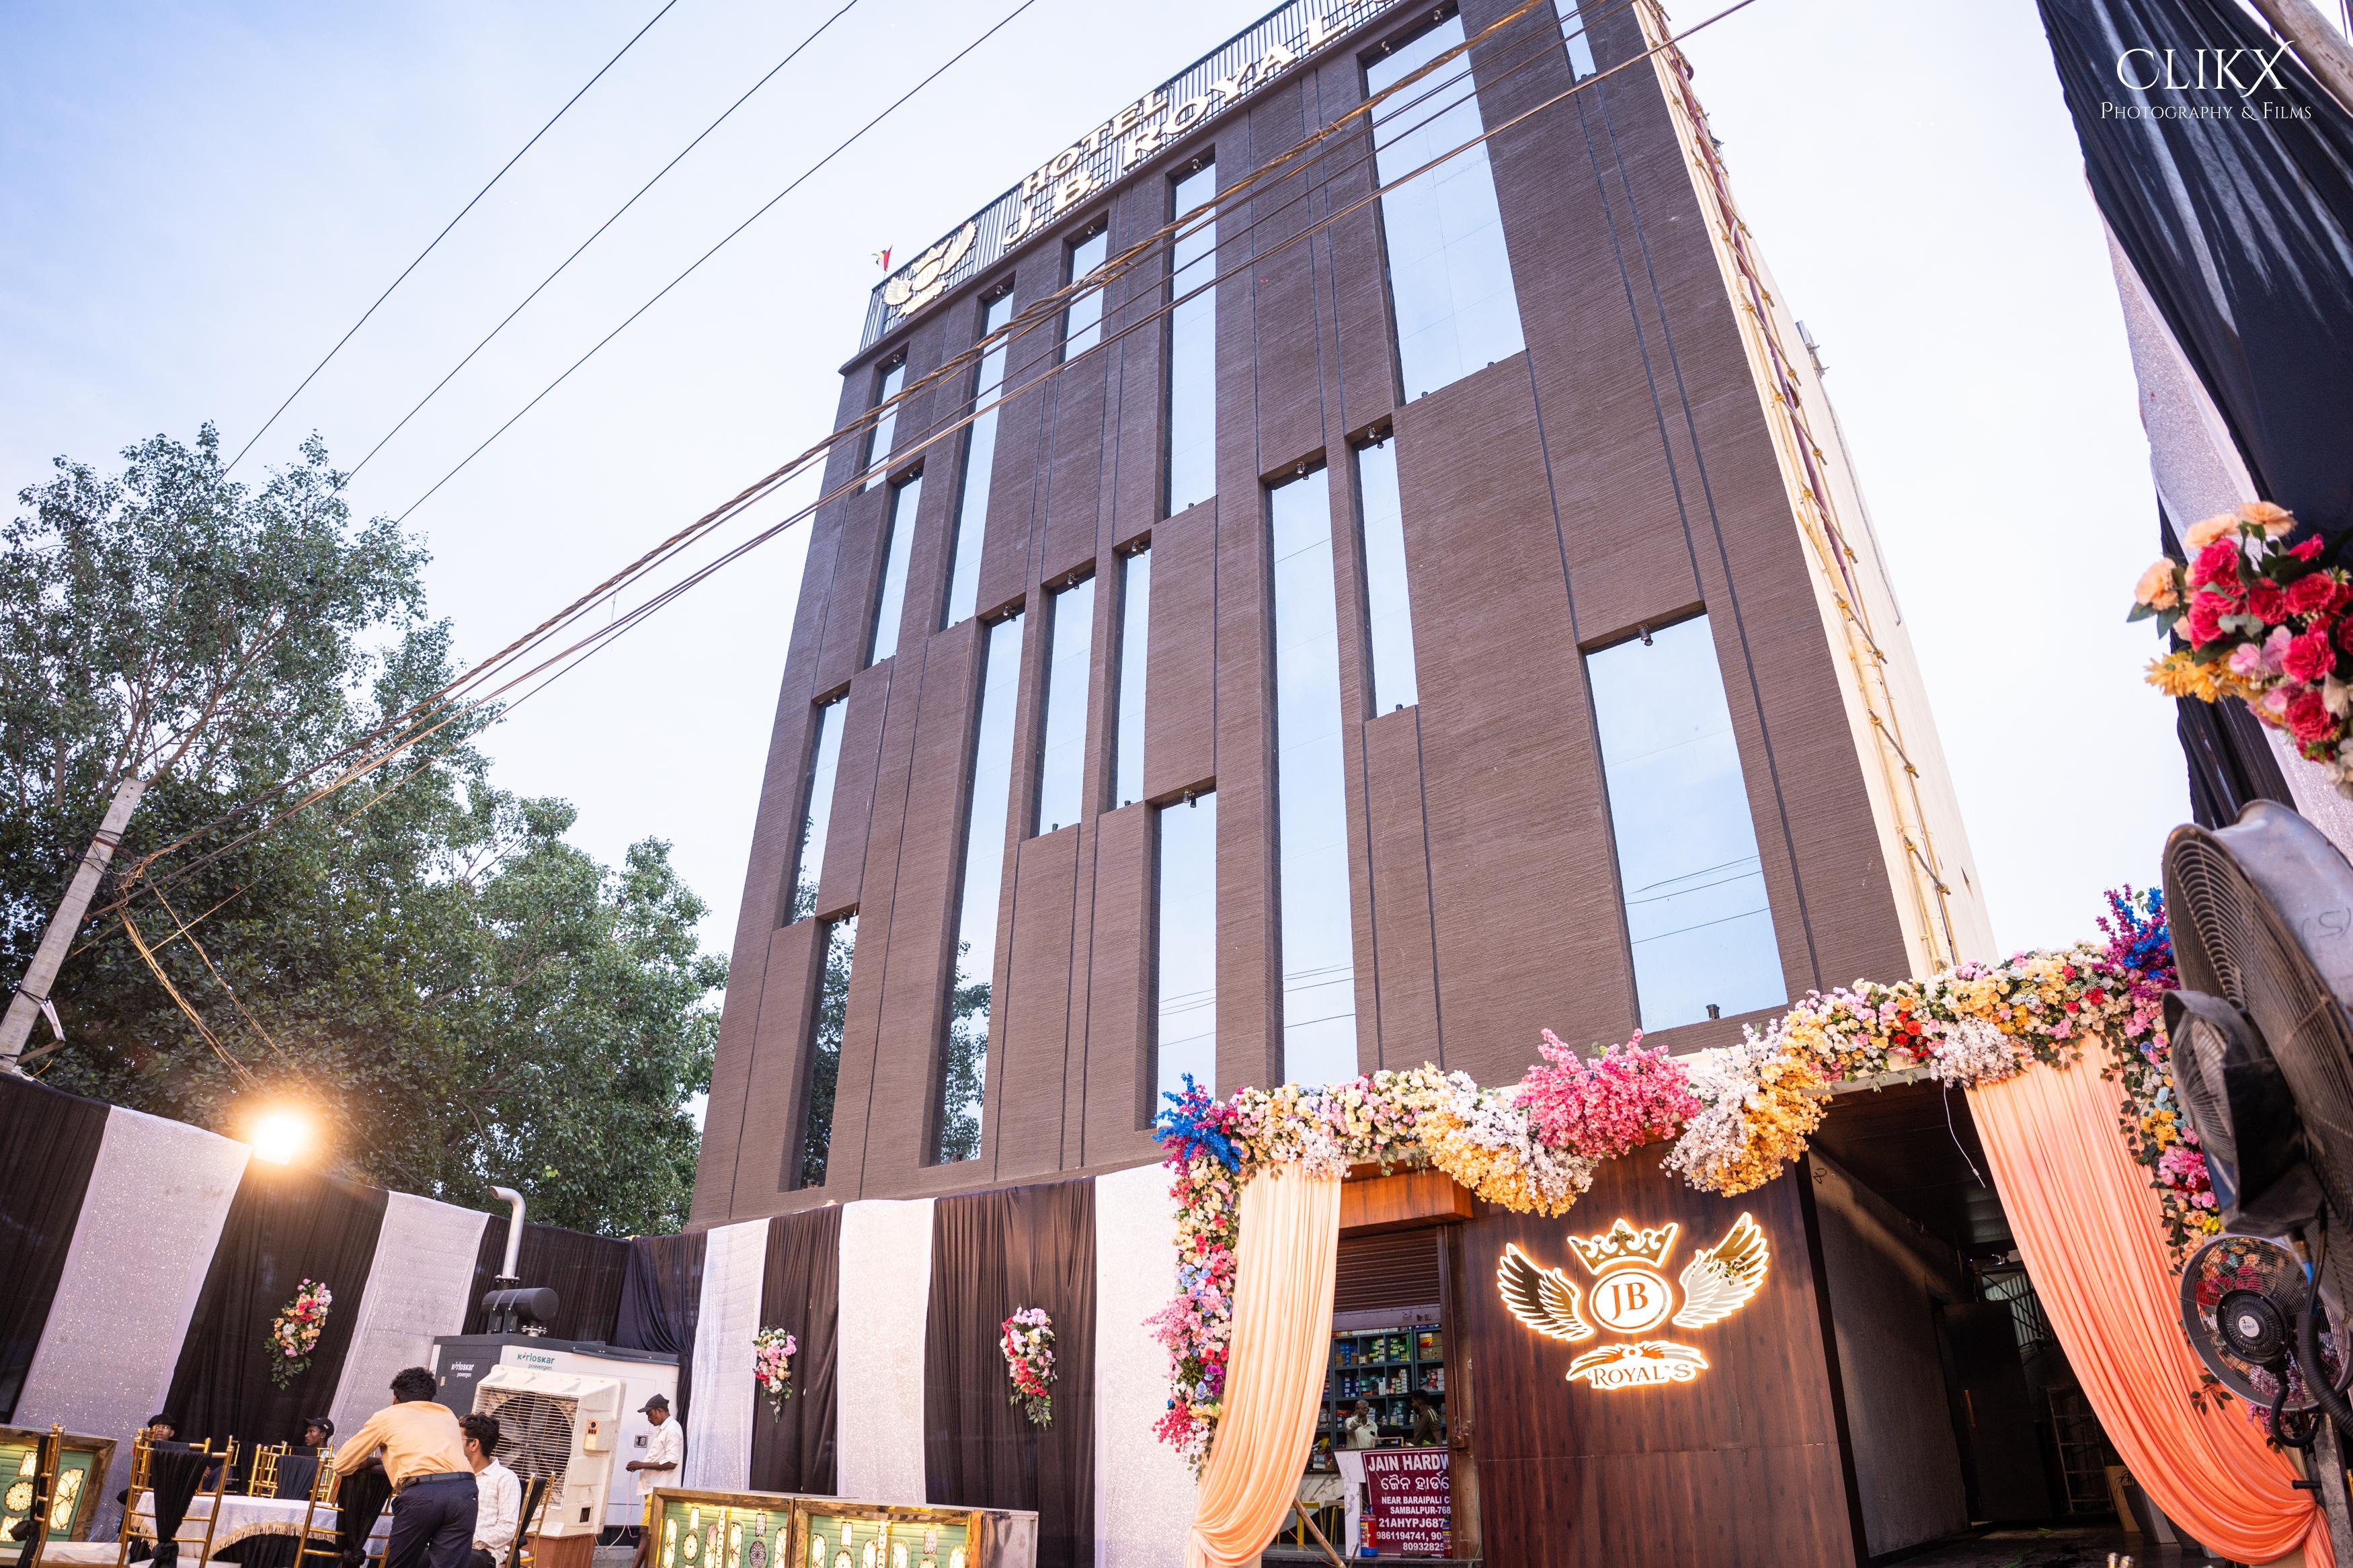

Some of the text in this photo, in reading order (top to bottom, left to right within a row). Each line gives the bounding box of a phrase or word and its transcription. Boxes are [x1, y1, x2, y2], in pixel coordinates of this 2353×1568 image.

[1021, 91, 1168, 203] HOTEL
[1610, 1282, 1648, 1321] JB
[1368, 1455, 1400, 1471] JAIN
[1382, 1496, 1401, 1504] NEAR
[1403, 1496, 1442, 1504] BARAIPALI
[1390, 1506, 1451, 1514] SAMBALPUR-768
[1379, 1518, 1447, 1528] 21AHYPJ687
[1431, 1532, 1443, 1540] 90
